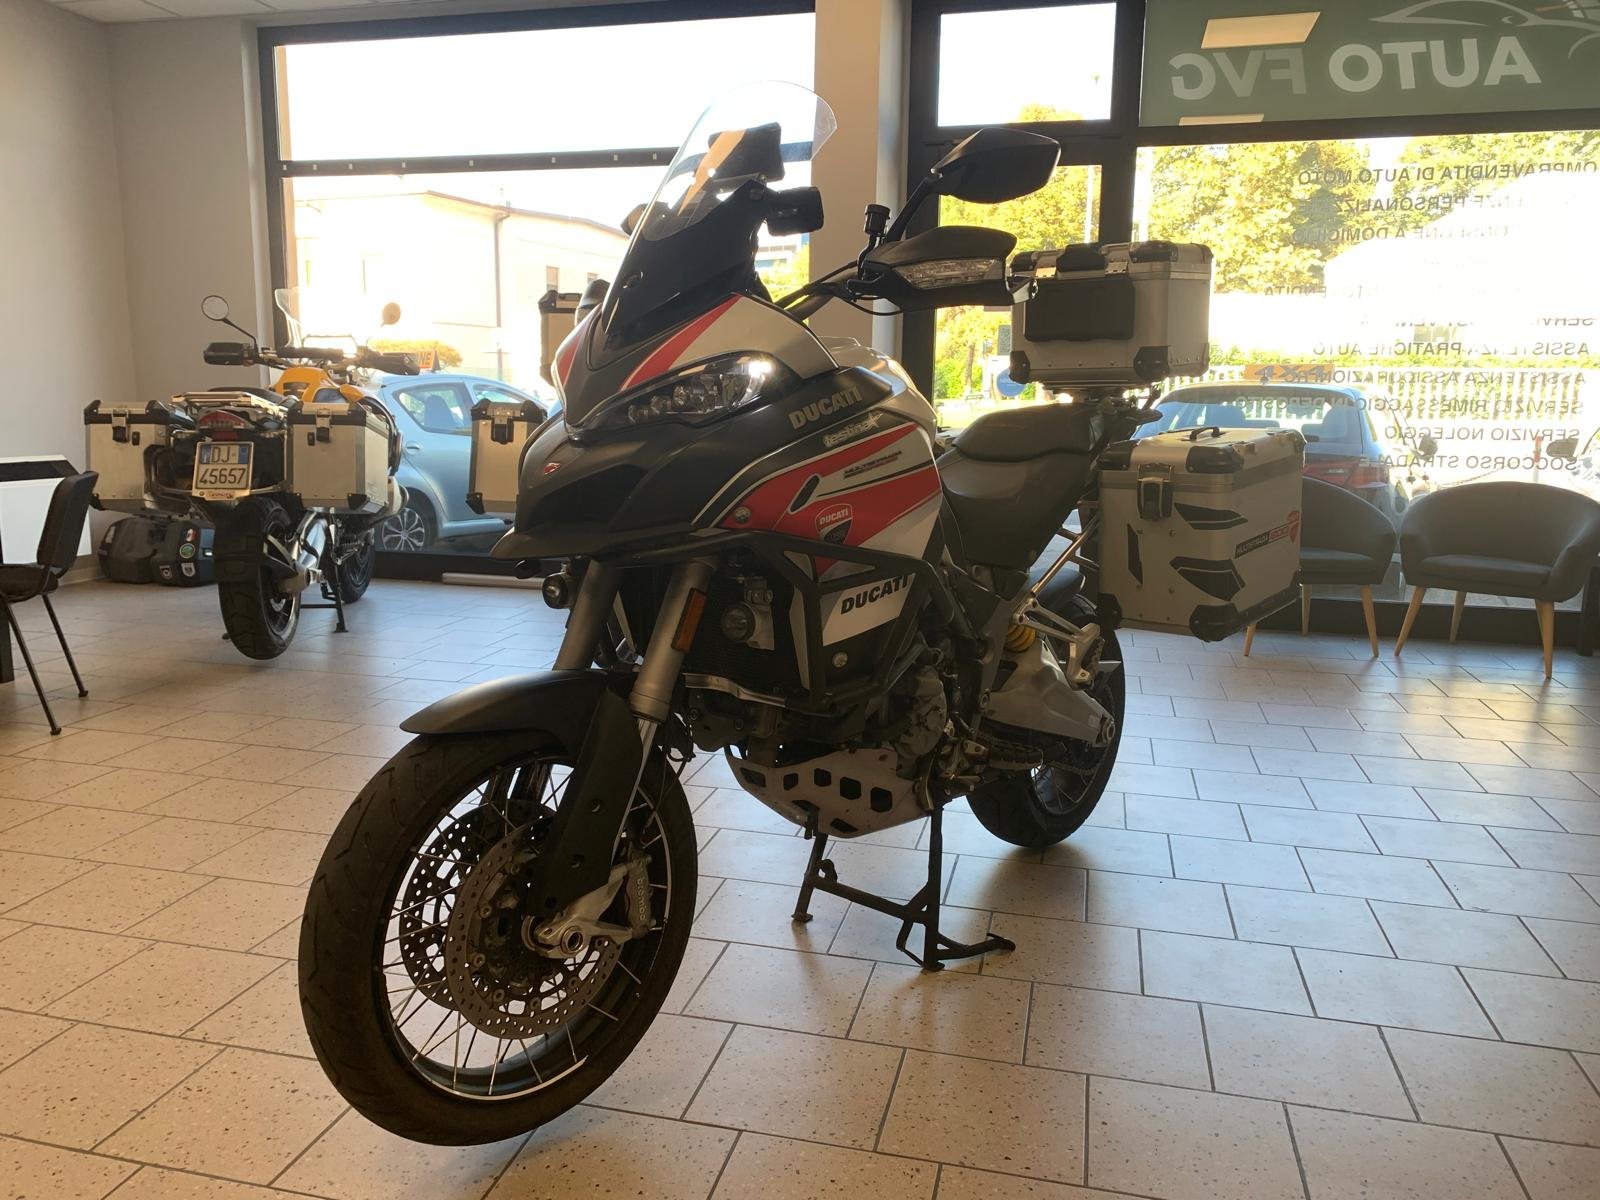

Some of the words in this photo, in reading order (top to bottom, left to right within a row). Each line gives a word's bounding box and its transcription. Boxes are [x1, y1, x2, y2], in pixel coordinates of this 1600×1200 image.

[788, 386, 864, 430] DUCATI
[211, 446, 231, 463] DJ
[199, 467, 246, 485] 45657
[819, 508, 849, 525] DUCATI
[840, 575, 908, 615] DUCATI
